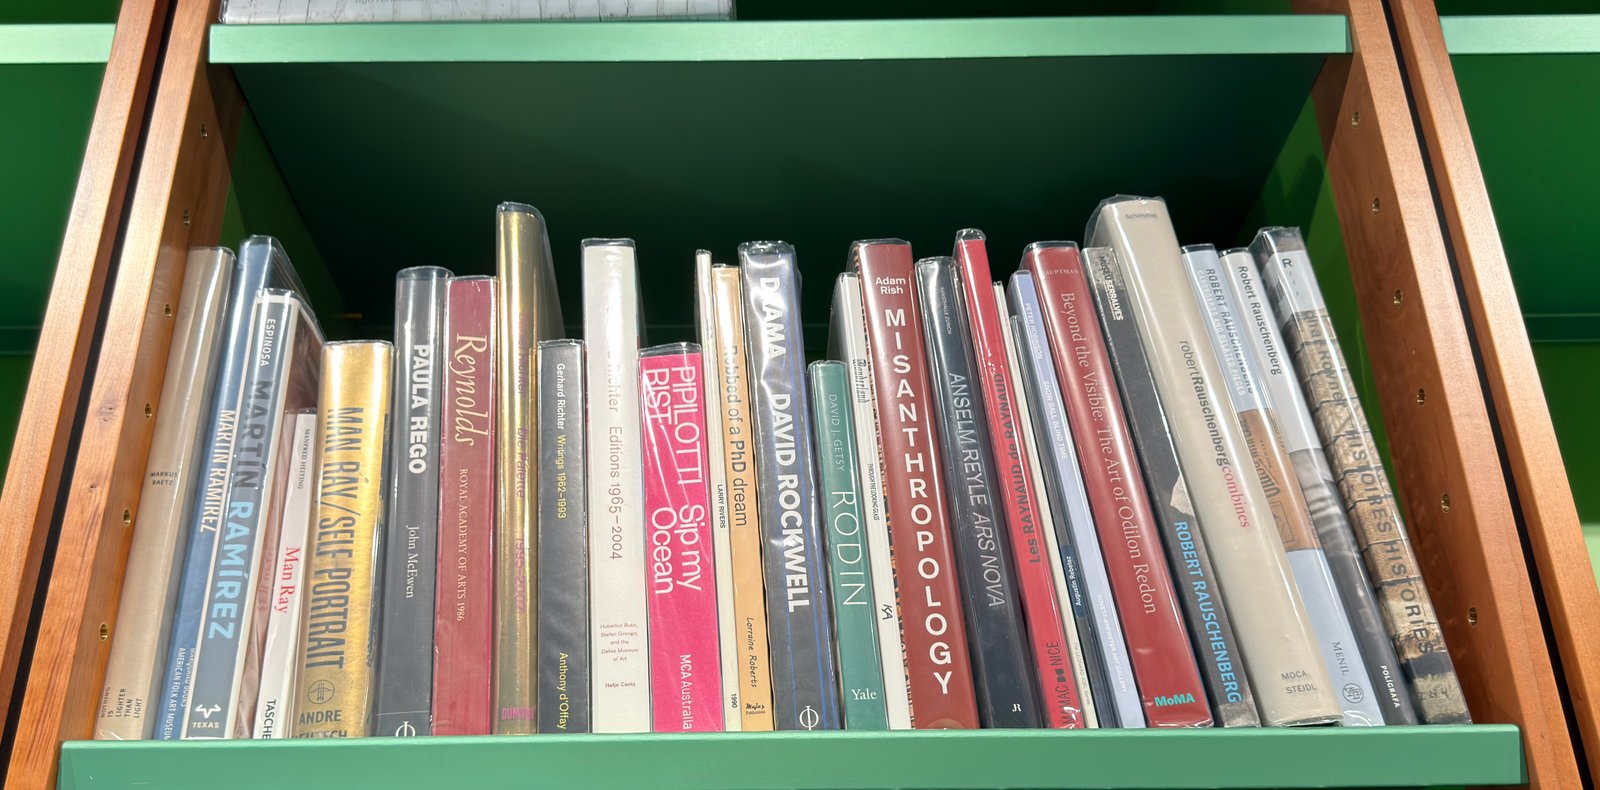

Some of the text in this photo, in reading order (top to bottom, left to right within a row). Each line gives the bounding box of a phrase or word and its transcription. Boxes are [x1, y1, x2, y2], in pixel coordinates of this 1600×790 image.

[875, 277, 906, 285] Adam
[880, 286, 904, 295] Rish
[1206, 268, 1225, 307] ROBERT
[1024, 303, 1035, 324] PETER
[1238, 265, 1282, 376] Robert Rauschenberg
[260, 318, 276, 366] ESPINOSA
[448, 332, 489, 446] Reynolds
[556, 363, 566, 397] Gerhard
[645, 368, 672, 425] RIST
[325, 407, 365, 453] MAN
[408, 344, 432, 474] PAULA REGO
[556, 399, 566, 430] Richter
[671, 365, 703, 485] PIPILOTTI
[728, 408, 743, 423] of
[730, 426, 740, 435] a
[828, 394, 845, 472] DAVID J. GETSY
[297, 428, 311, 491] MANFRED HEITING
[555, 434, 567, 470] Writings
[609, 426, 623, 478] Editions
[730, 440, 747, 473] PhD
[759, 277, 810, 613] DAMA DAVID ROCKWELL
[994, 373, 1042, 564] Les RAYNAUD de RAYNAUD
[1060, 292, 1156, 614] Beyond the Visible: The Art of Odilon Redon
[867, 463, 875, 482] THROUGH
[949, 372, 1006, 607] ANSELM REYLE ARS NOVA
[207, 380, 273, 640] MARTÍN RAMÍREZ
[608, 482, 624, 560] 1965–2004
[734, 479, 748, 527] dream
[885, 308, 953, 695] MISANTHROPOLOGY
[405, 525, 420, 598] John McEwen
[456, 468, 469, 622] ROYAL ACADEMY OF ARTS 1986
[651, 507, 677, 594] Ocean
[674, 504, 705, 591] Sip my
[831, 491, 868, 605] RODIN
[273, 546, 301, 614] Man Ray
[1072, 579, 1082, 606] Augustin
[1383, 541, 1433, 654] HISTORIES
[305, 569, 351, 669] PORTRAIT
[1174, 521, 1242, 704] ROBERT RAUSCHENBERG
[173, 647, 186, 681] AMERICAN
[746, 617, 758, 688] Lorraine Roberts
[1046, 641, 1062, 666] NICE
[1281, 670, 1308, 681] MOCA
[1331, 641, 1347, 676] MENIL
[115, 688, 127, 717] LIGHTER
[124, 699, 134, 717] THAN
[133, 698, 143, 718] LIGHT
[168, 698, 177, 711] ART
[170, 681, 180, 698] FOLK
[556, 652, 569, 730] Anthony d'Offay
[679, 654, 693, 730] MCA Australia
[851, 688, 877, 700] Yale
[1154, 693, 1196, 707] MoMA
[1286, 683, 1317, 694] STEIDL
[107, 709, 115, 718] IS
[192, 721, 220, 729] TEXAS
[298, 709, 342, 726] ANDRE
